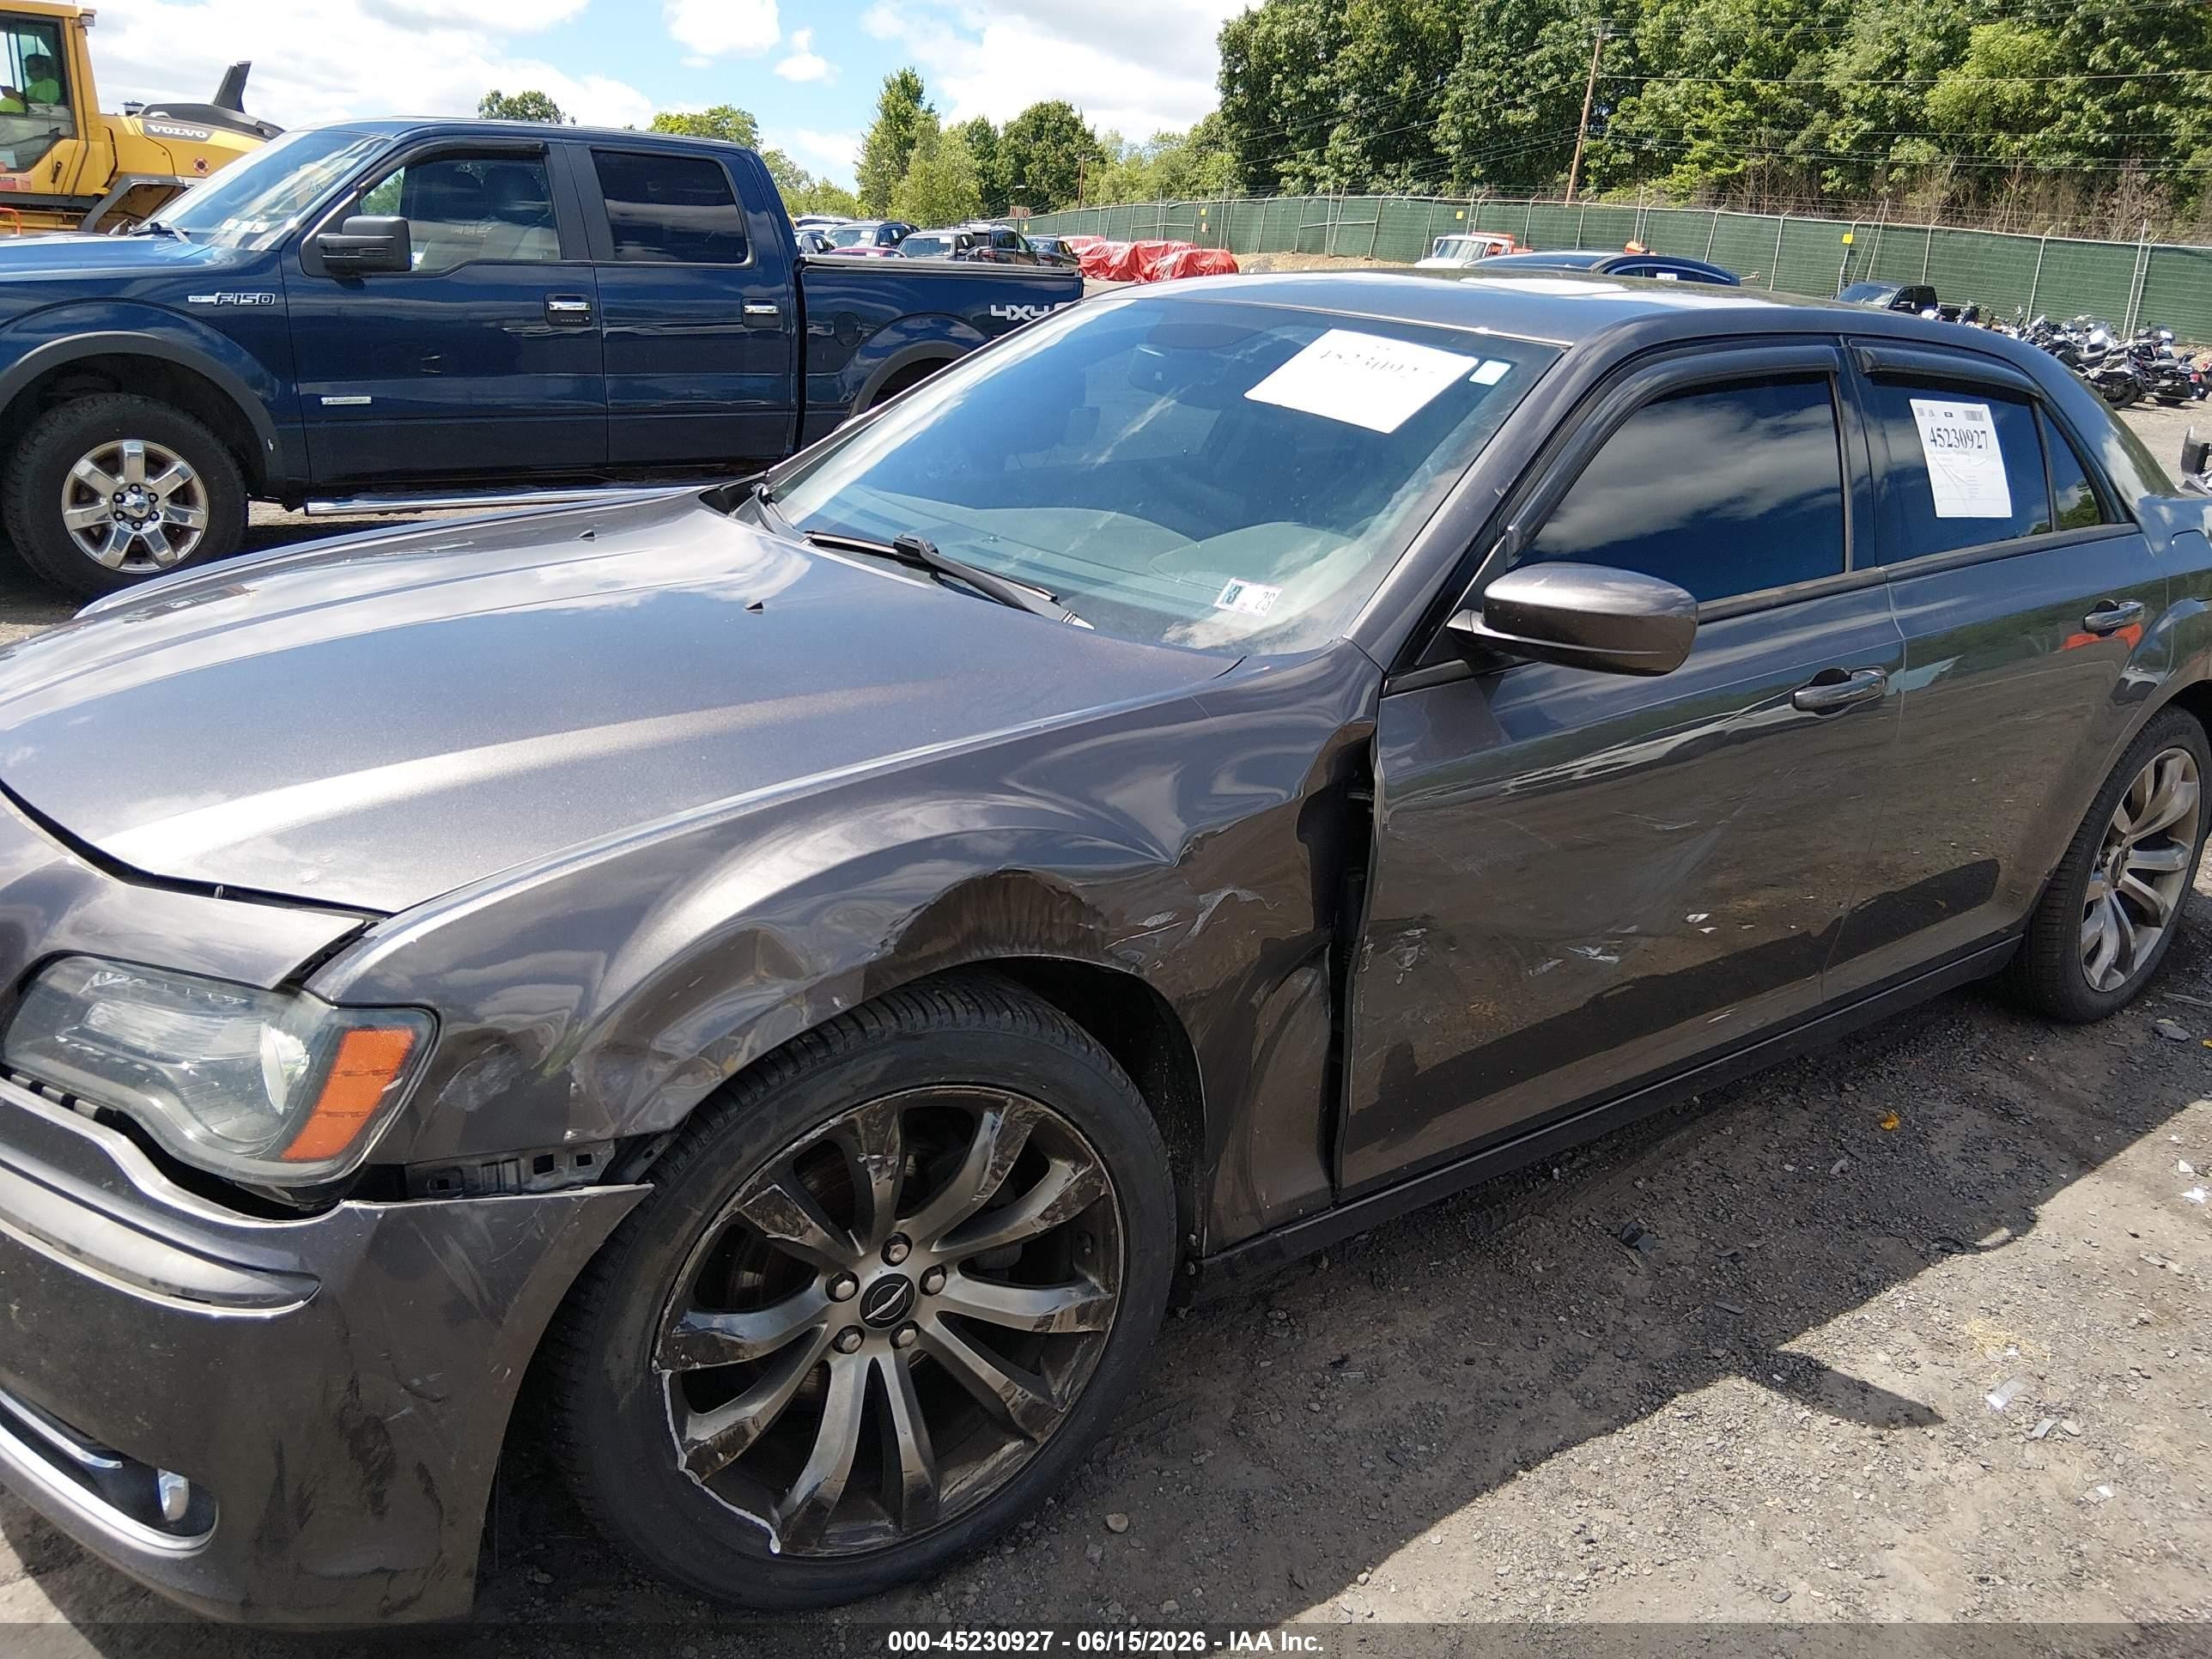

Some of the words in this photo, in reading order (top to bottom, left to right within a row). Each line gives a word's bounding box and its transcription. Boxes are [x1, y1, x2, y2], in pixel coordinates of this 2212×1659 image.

[147, 124, 208, 138] VOLVO
[214, 292, 275, 306] F-150
[1929, 426, 1988, 450] 45230927
